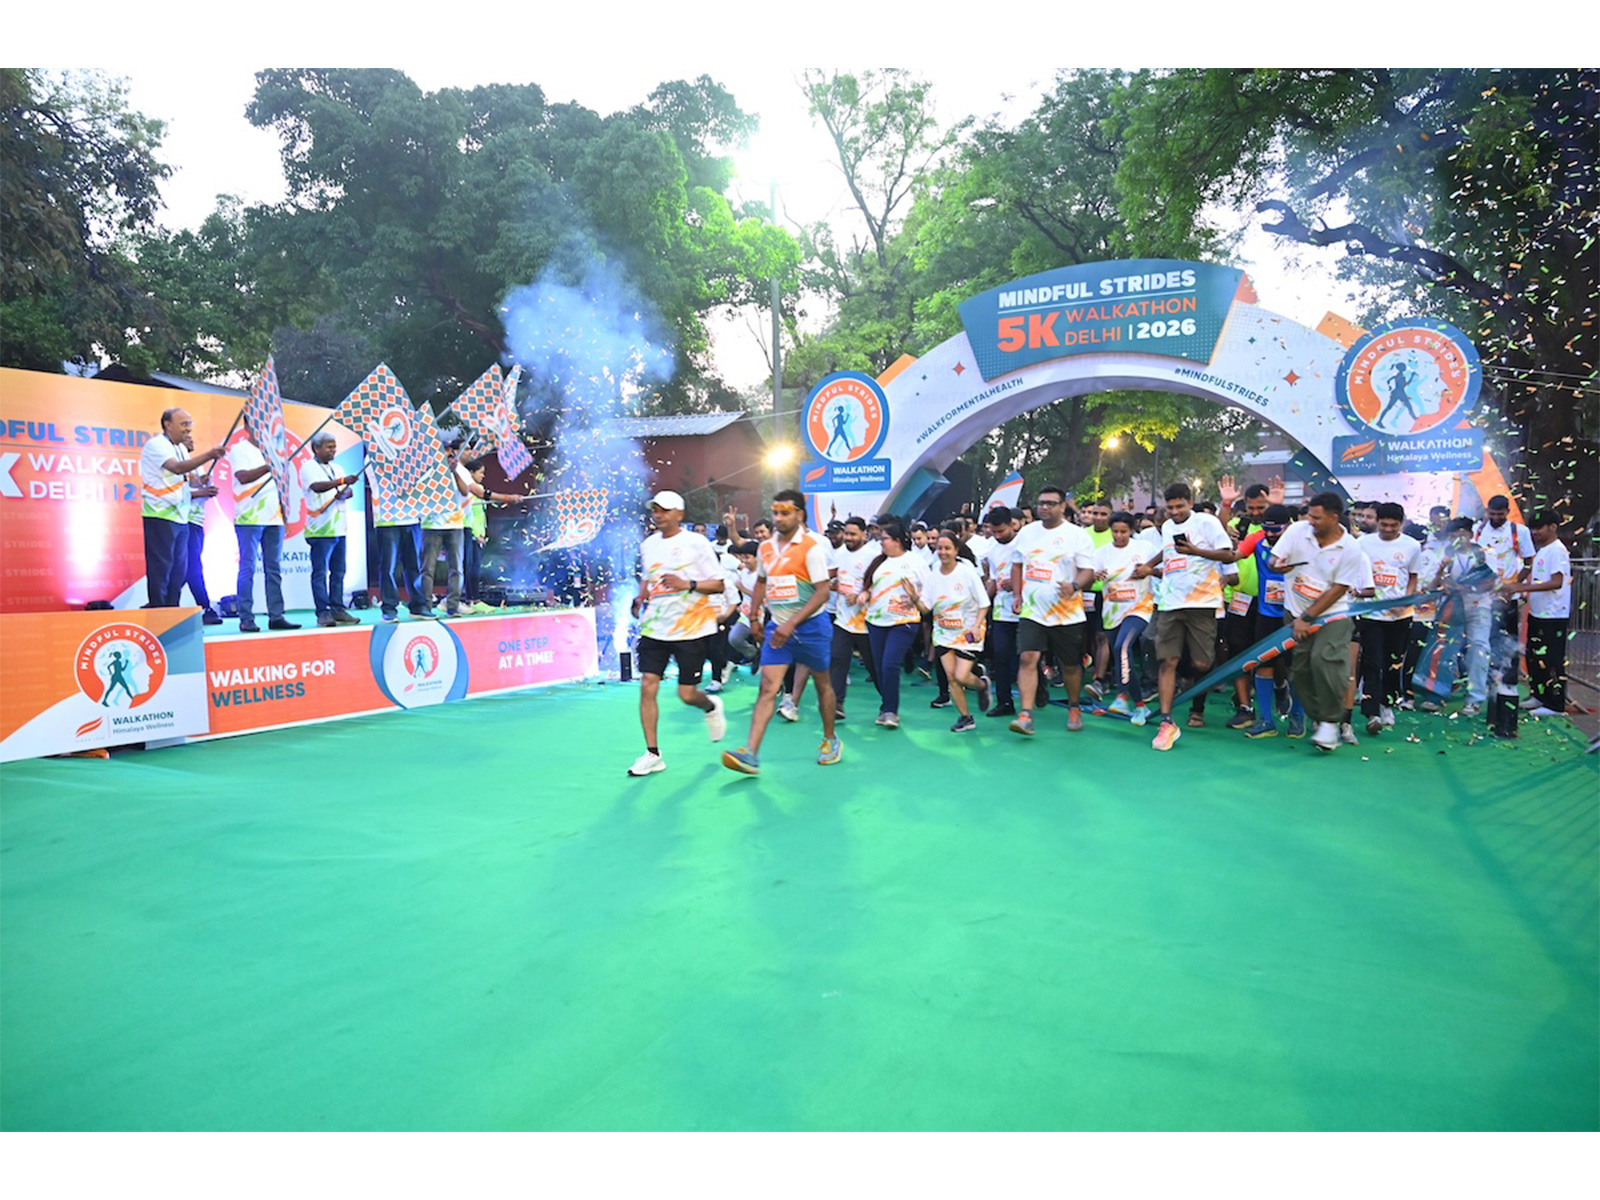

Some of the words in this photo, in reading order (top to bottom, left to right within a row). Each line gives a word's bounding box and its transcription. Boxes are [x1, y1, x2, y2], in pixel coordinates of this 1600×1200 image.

[998, 282, 1093, 309] MINDFUL
[1099, 269, 1196, 296] STRIDES
[1065, 297, 1196, 323] WALKATHON
[997, 311, 1060, 353] 5K
[1065, 326, 1121, 346] DELHI
[1136, 318, 1196, 340] 2026
[1354, 337, 1405, 384] MINDFUL
[1413, 335, 1461, 378] STRIDES
[1174, 367, 1269, 407] #MINDFULSTRIDES
[812, 385, 844, 423] MINDFUL
[848, 385, 877, 419] STRIDES
[916, 377, 1024, 444] #WALKFORMENTALHEALTH
[1386, 453, 1428, 462] Himalaya
[1431, 451, 1472, 460] Wellness
[1387, 437, 1473, 451] WALKATHON
[27, 452, 143, 476] WALKAT
[833, 465, 885, 475] WALKATHON
[29, 480, 105, 502] DELHI
[80, 630, 119, 670] MINDFUL
[125, 629, 162, 665] STRIDES
[498, 638, 521, 653] ONE
[525, 635, 550, 650] STEP
[209, 663, 298, 688] WALKING
[301, 659, 336, 678] FOR
[499, 654, 513, 669] AT
[515, 654, 524, 667] A
[211, 681, 306, 708] WELLNESS
[112, 710, 174, 725] WALKATHON
[112, 725, 144, 735] Himalaya
[146, 721, 175, 731] Wellness
